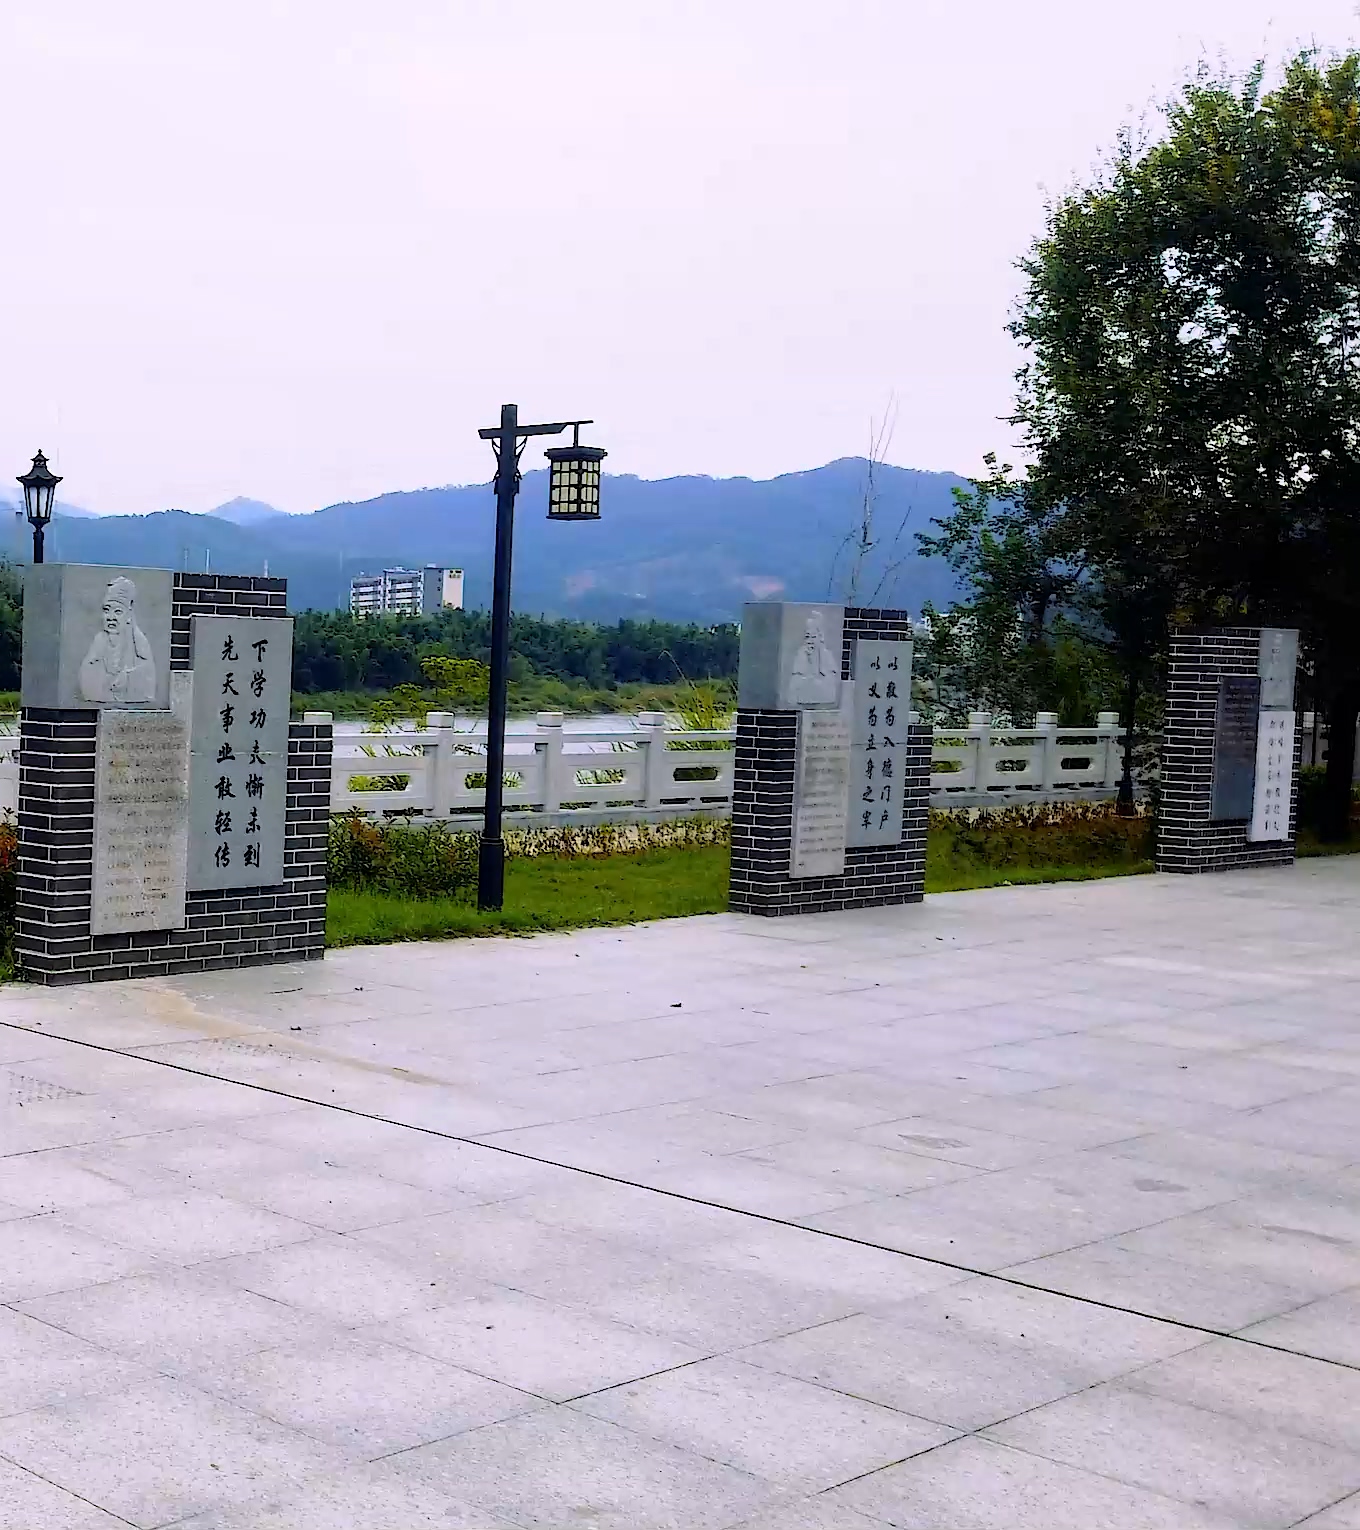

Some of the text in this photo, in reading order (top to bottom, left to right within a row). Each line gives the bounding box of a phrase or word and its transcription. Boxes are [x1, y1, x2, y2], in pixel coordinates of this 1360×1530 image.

[214, 634, 239, 868] 先天事业敢轻传
